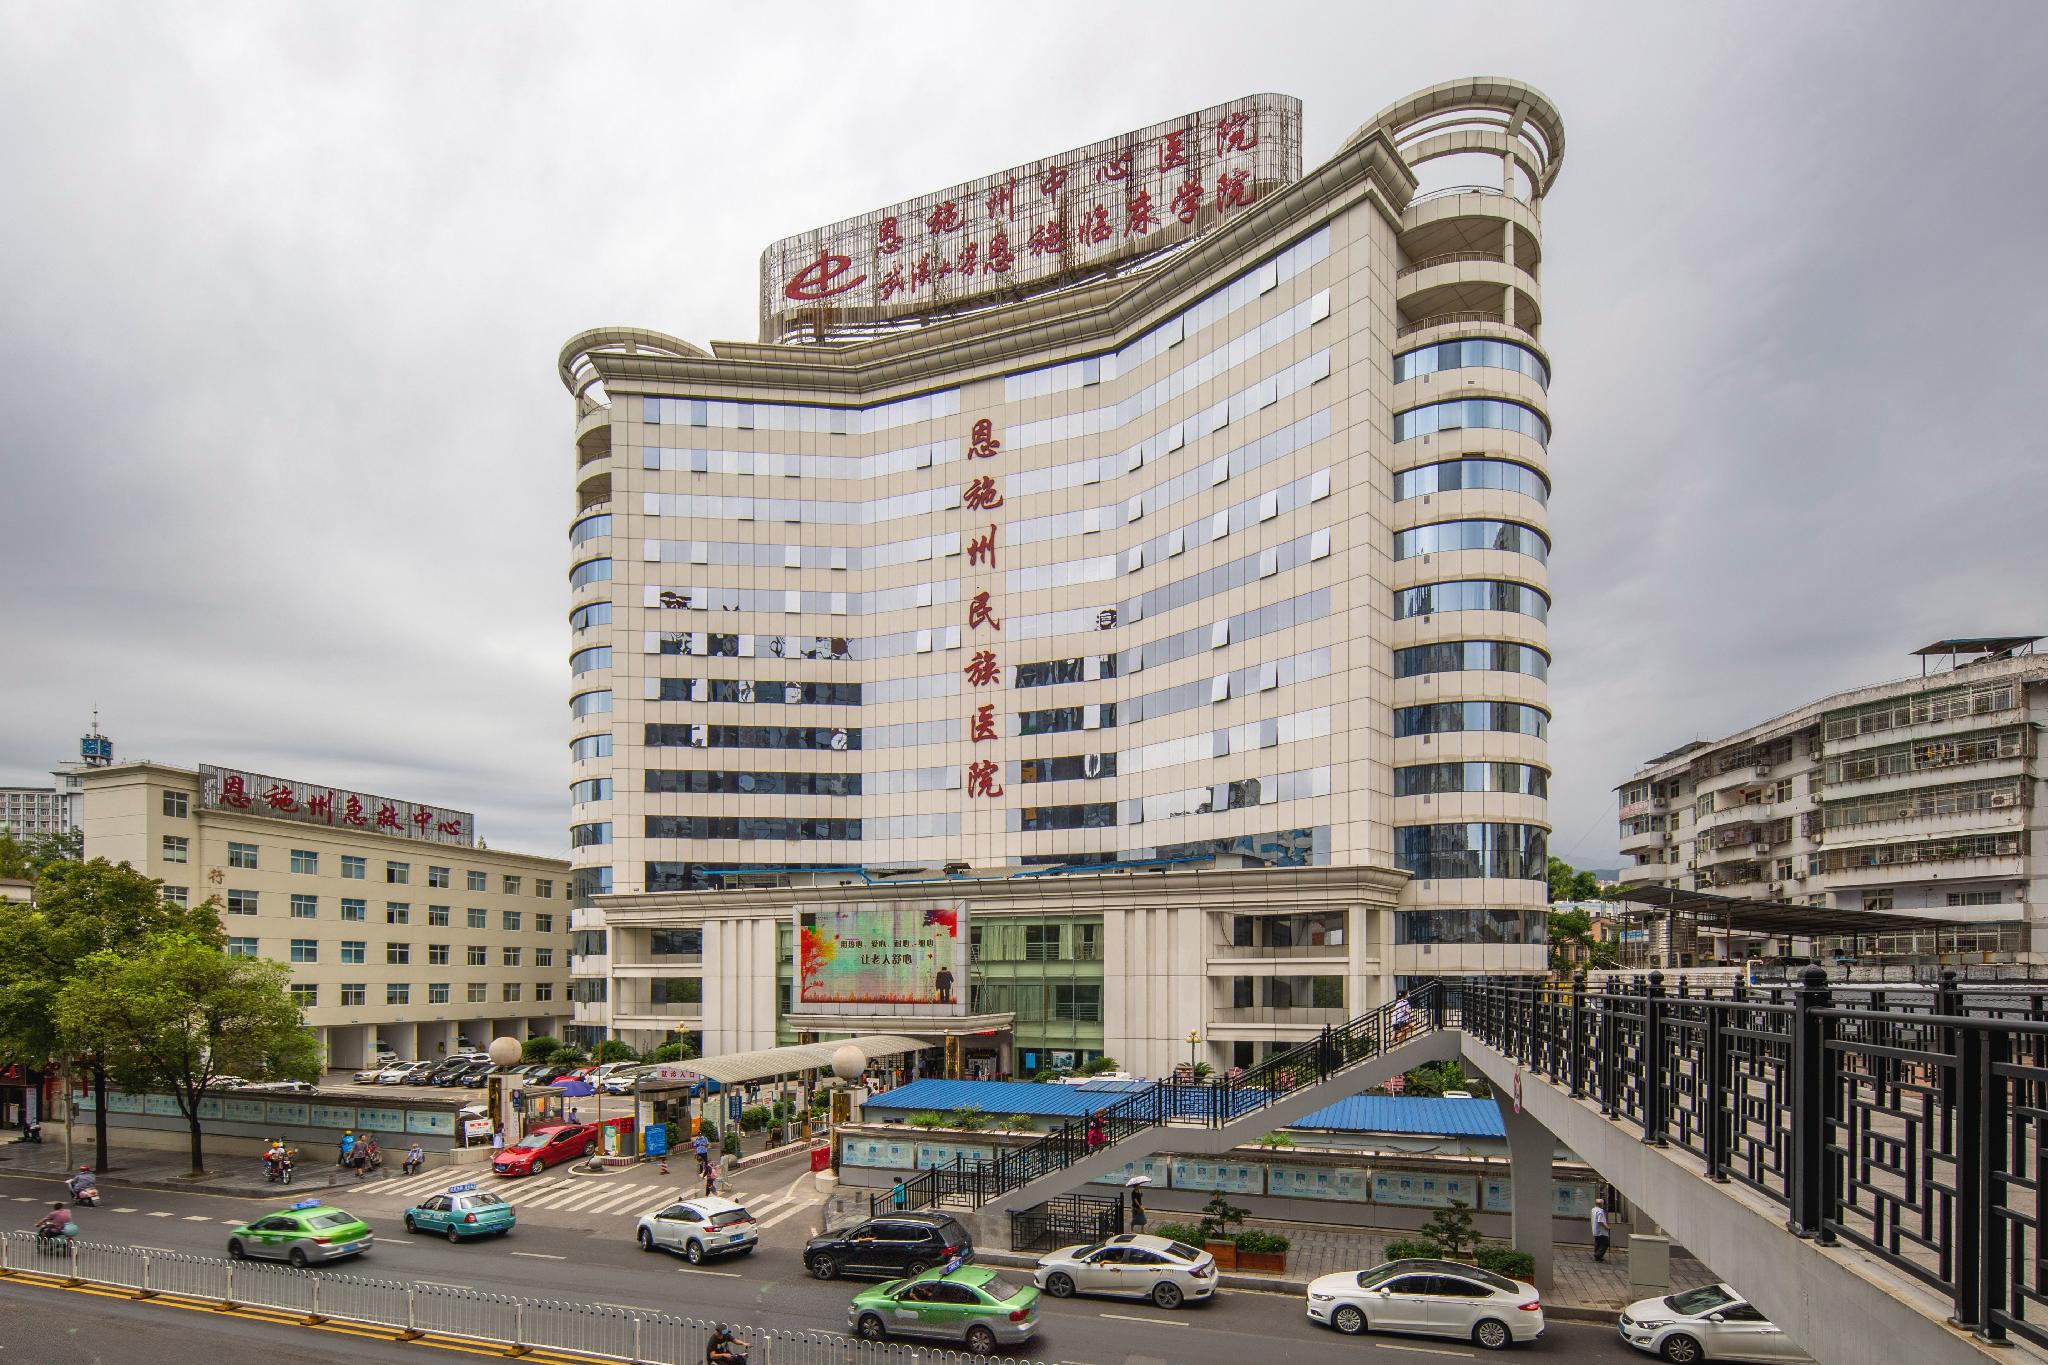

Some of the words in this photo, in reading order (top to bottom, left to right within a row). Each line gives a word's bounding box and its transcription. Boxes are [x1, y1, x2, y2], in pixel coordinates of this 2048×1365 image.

[876, 111, 1258, 258] 恩施州中心医院
[963, 418, 1004, 798] 恩施州民族医院
[219, 775, 462, 835] 恩施州急救中心
[861, 953, 913, 965] 让老人舒心
